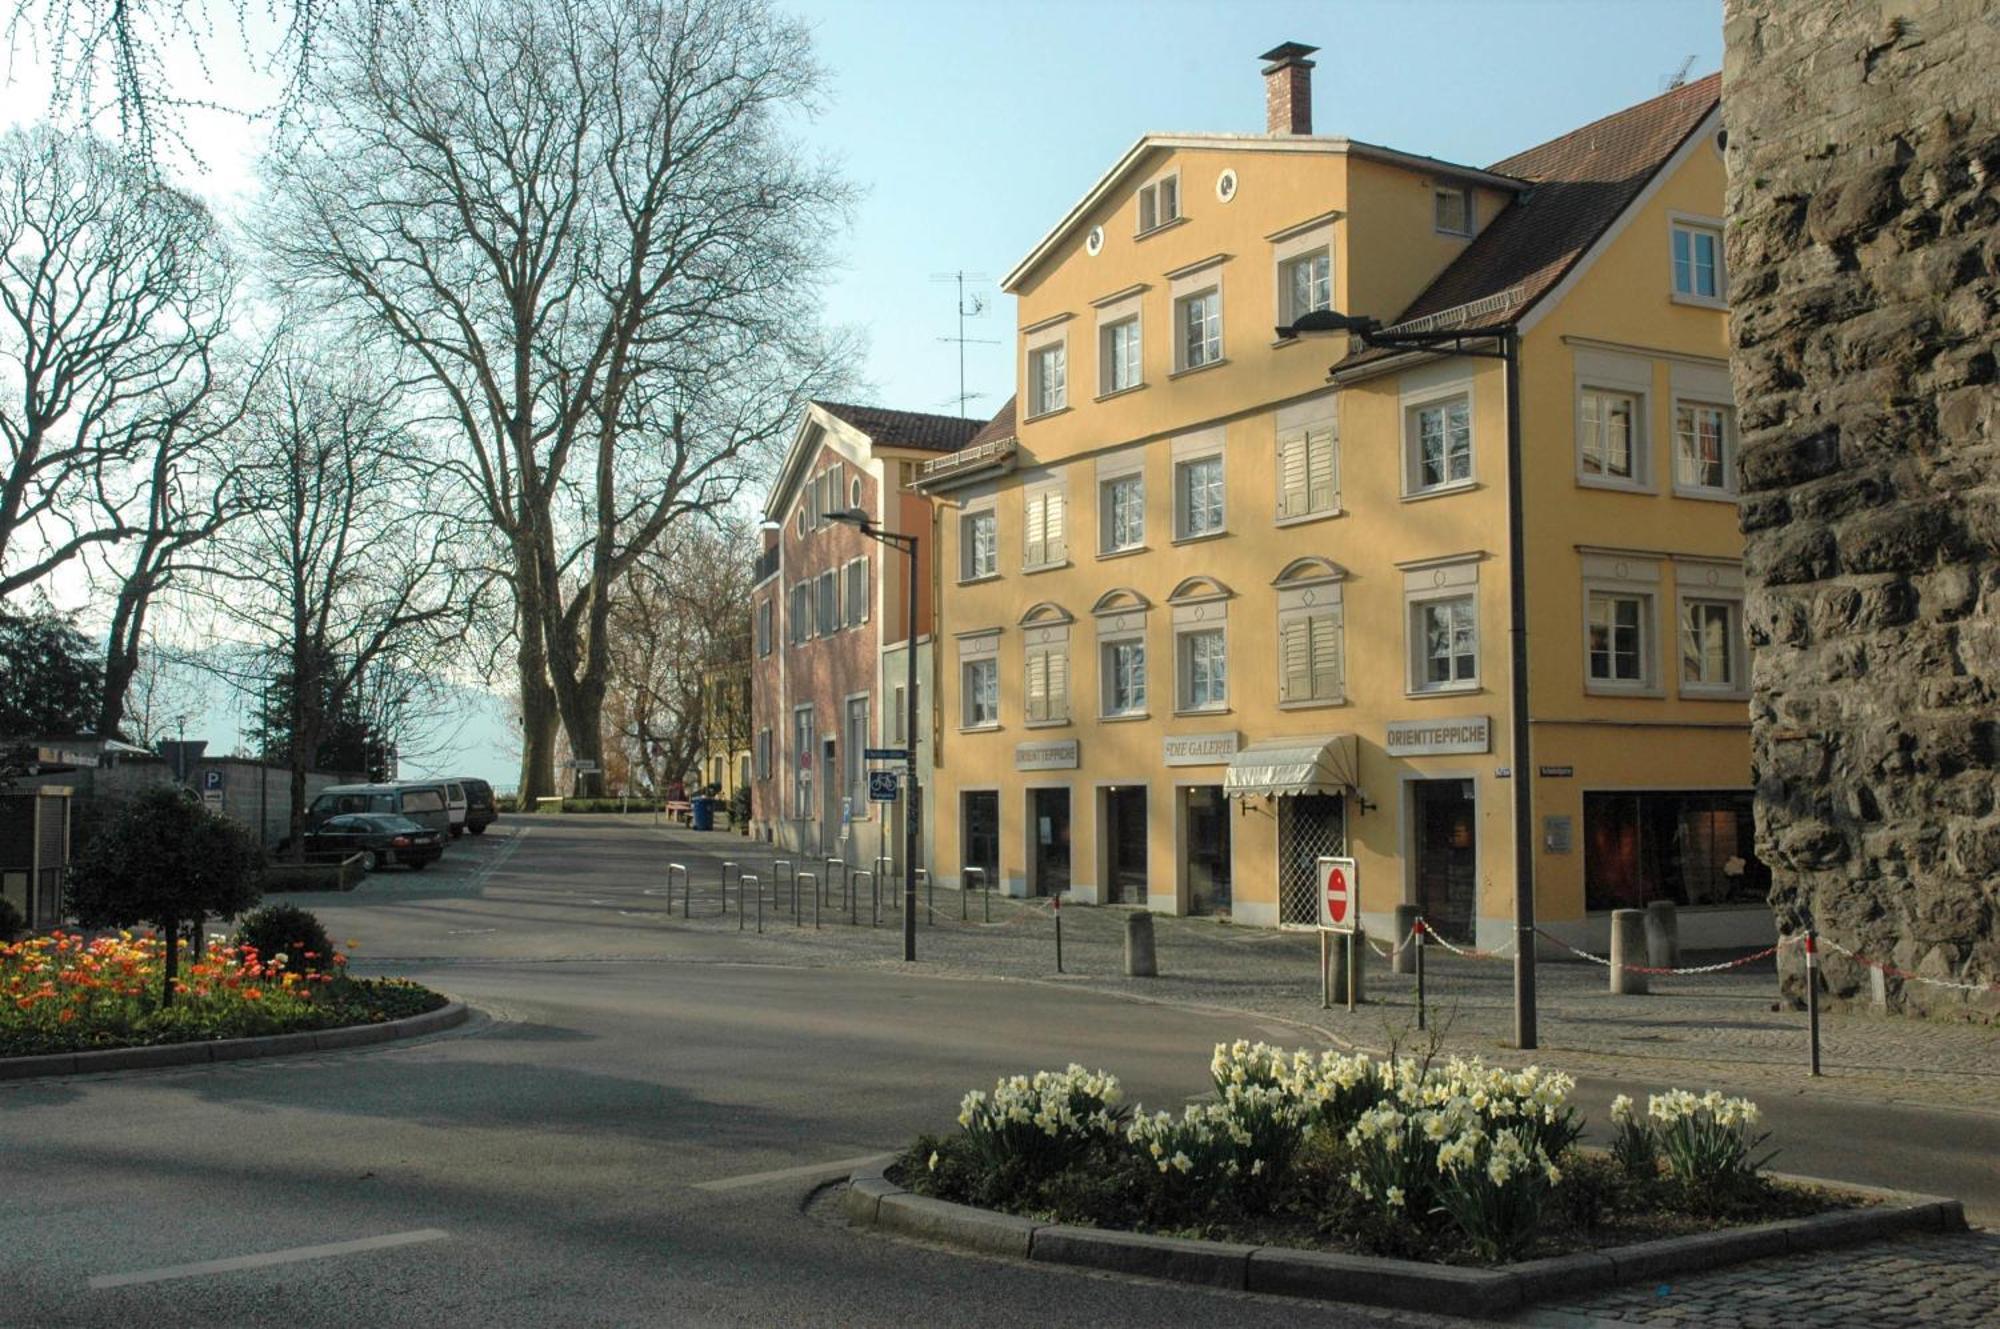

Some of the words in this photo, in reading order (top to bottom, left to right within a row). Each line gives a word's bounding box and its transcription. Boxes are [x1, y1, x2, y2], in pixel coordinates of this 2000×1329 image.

[1388, 725, 1485, 746] ORIENTTEPPICHE
[1188, 739, 1233, 757] GALERIE
[208, 772, 220, 789] P
